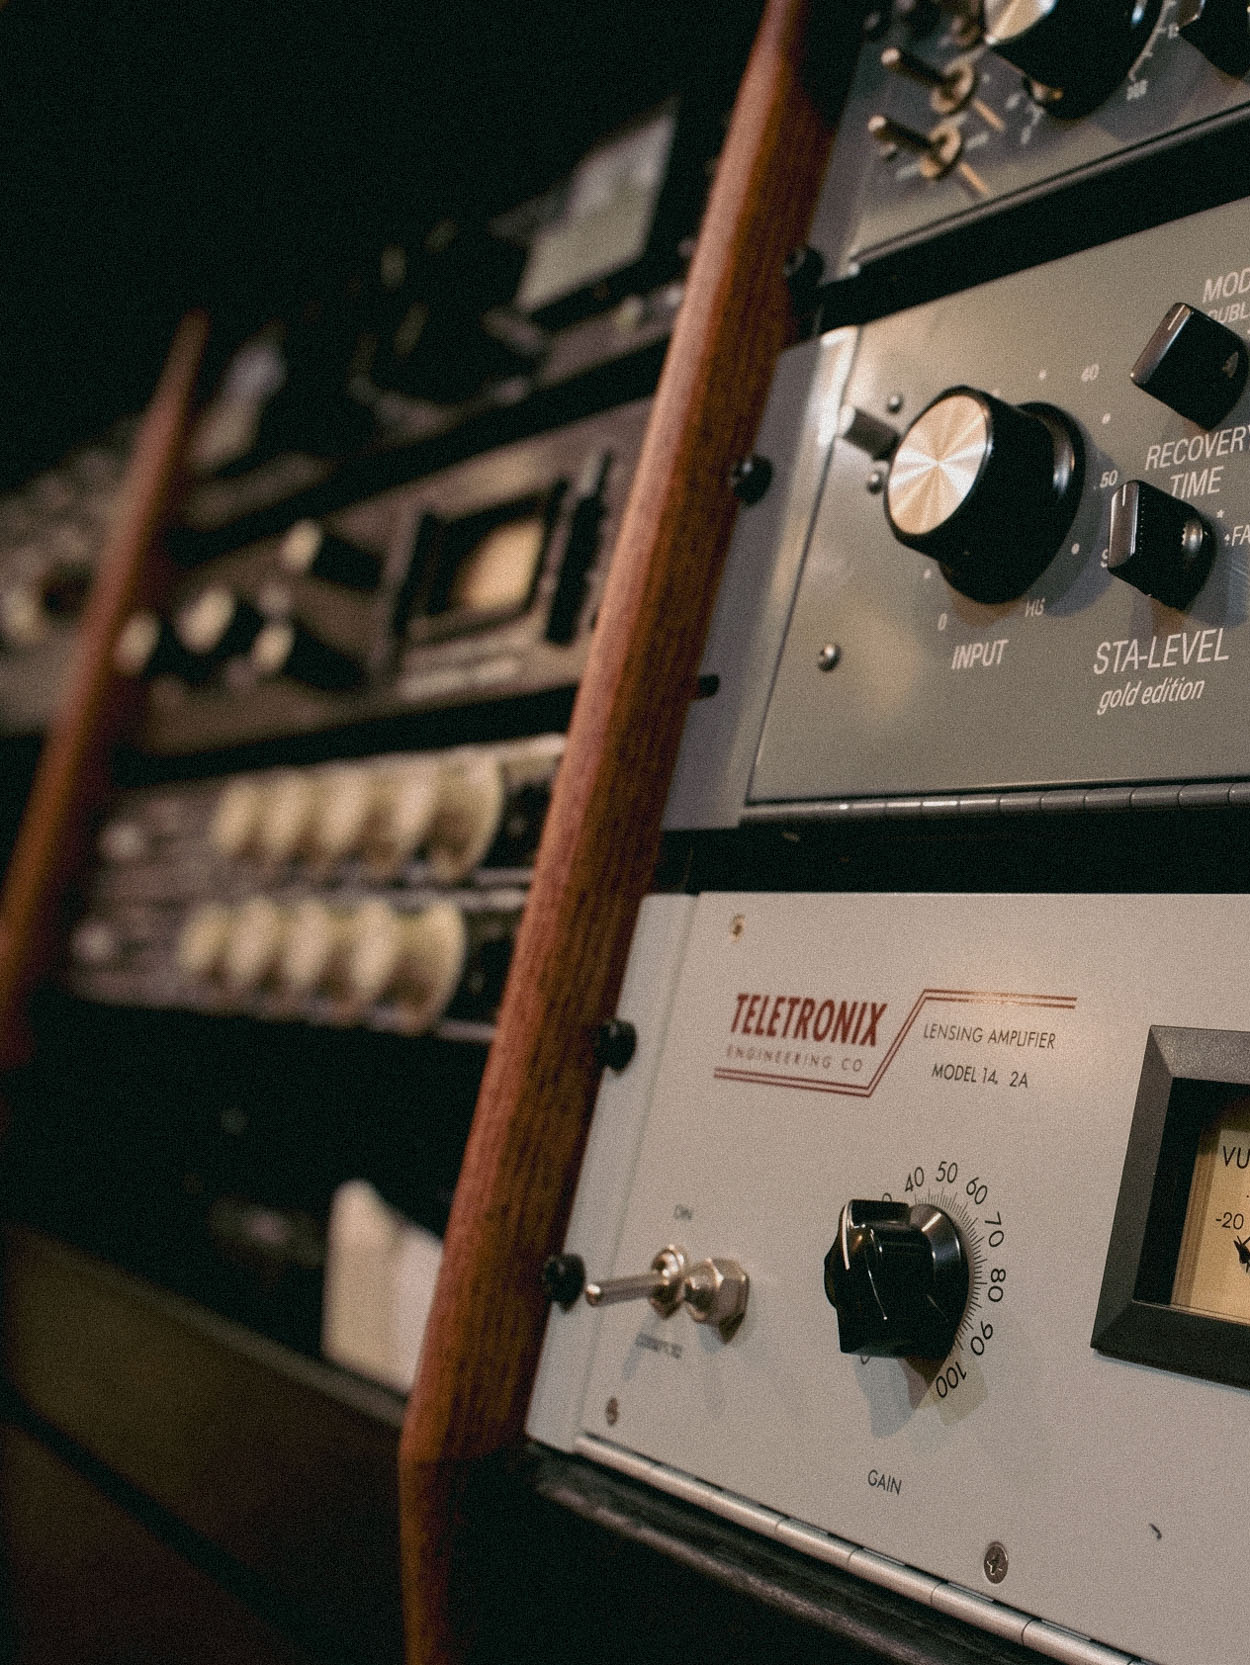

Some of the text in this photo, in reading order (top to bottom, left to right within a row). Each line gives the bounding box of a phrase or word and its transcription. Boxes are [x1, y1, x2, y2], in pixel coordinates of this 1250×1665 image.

[1170, 466, 1224, 499] TIME
[937, 612, 948, 631] 0
[951, 639, 1010, 670] INPUT
[1093, 627, 1229, 675] STA-LEVEL
[1097, 676, 1205, 715] gold edition
[731, 993, 888, 1047] TELETRONIX
[841, 1057, 863, 1073] CO
[931, 1063, 977, 1083] MODEL
[1009, 1071, 1028, 1088] 2A
[935, 1161, 958, 1183] 50
[1223, 1145, 1250, 1169] VU
[905, 1167, 925, 1193] 40
[966, 1176, 988, 1205] 60
[984, 1211, 1004, 1247] 70
[988, 1268, 1006, 1302] 80
[970, 1321, 994, 1356] 90
[935, 1361, 967, 1398] 100
[868, 1469, 902, 1495] GAIN
